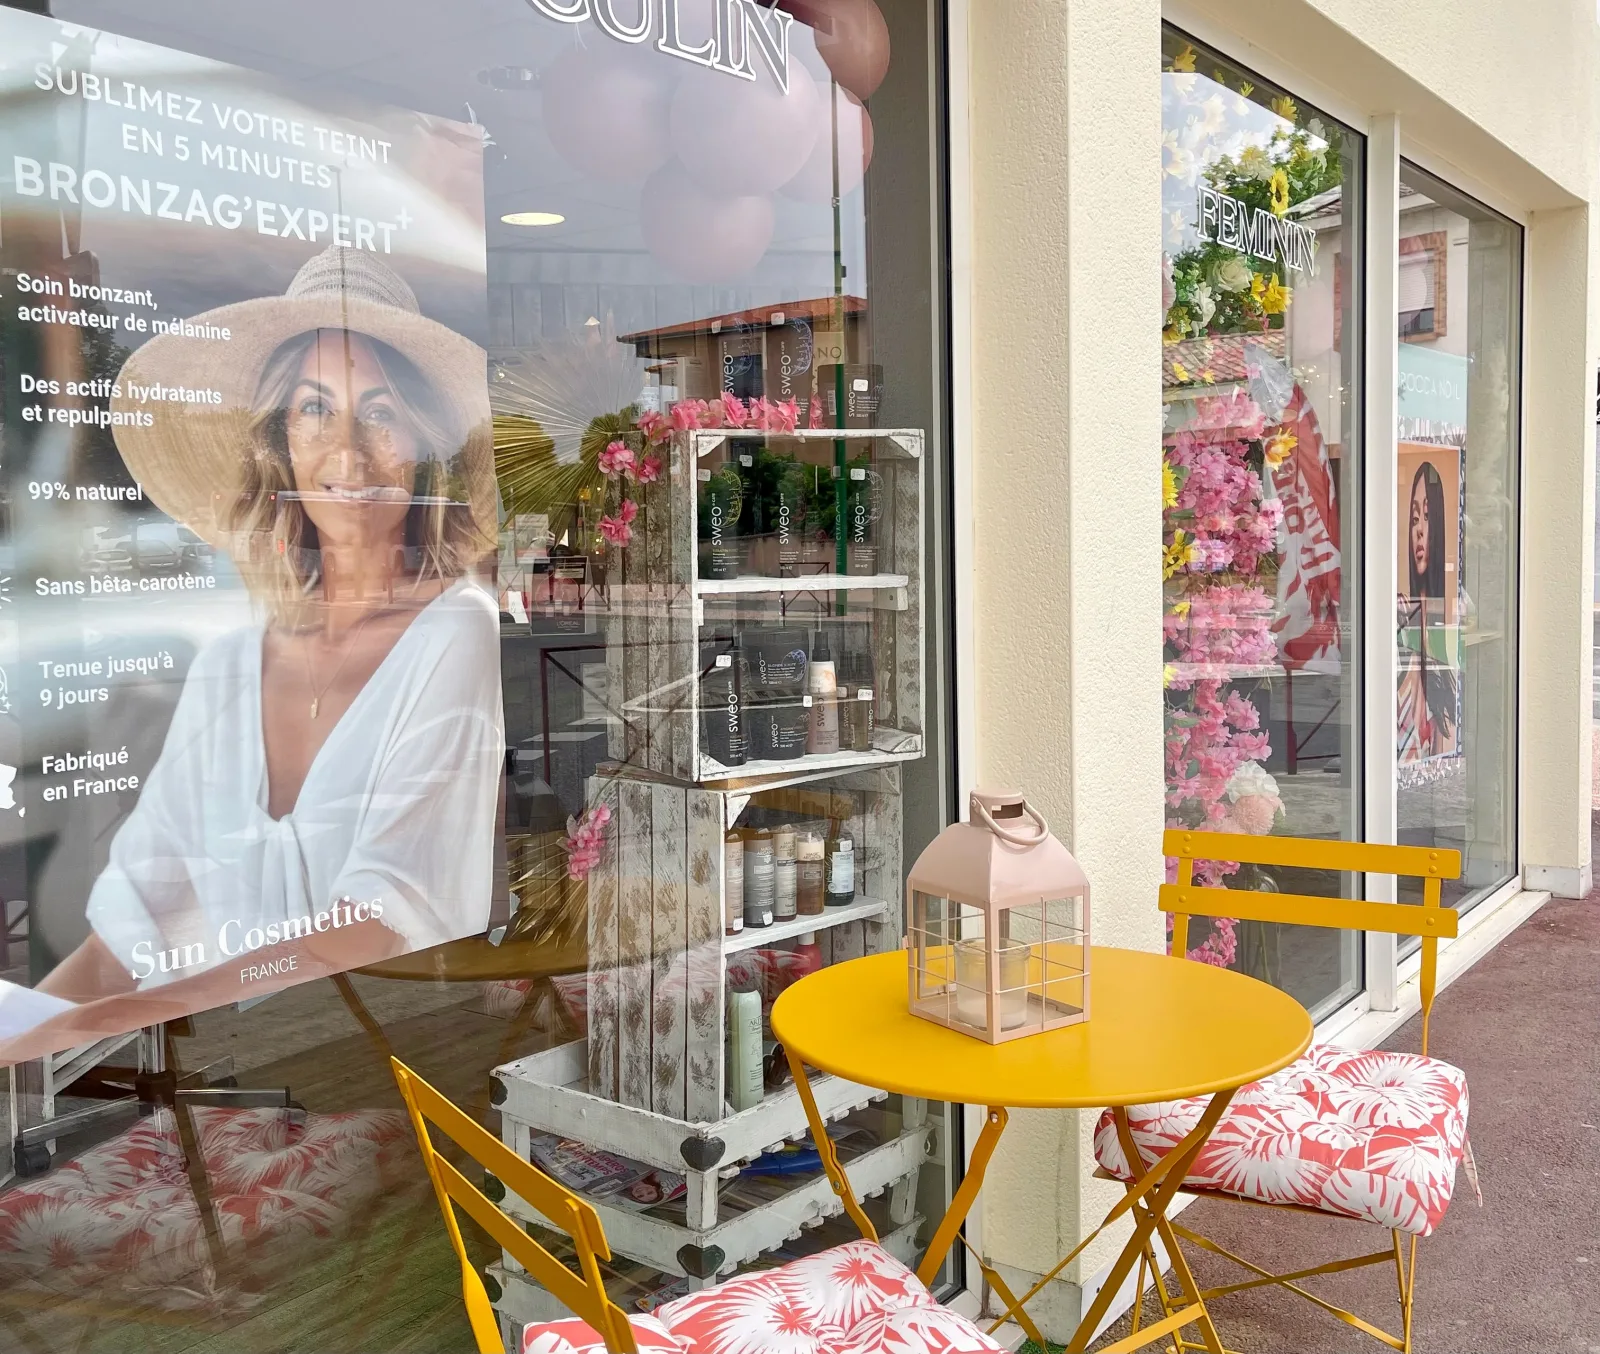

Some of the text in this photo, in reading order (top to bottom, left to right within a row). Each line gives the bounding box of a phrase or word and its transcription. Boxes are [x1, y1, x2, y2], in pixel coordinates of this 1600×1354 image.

[34, 63, 392, 164] SUBLIMEZ VOTRE TEINT
[122, 124, 332, 188] EN 5 MINUTES
[1197, 185, 1316, 277] FEMININ
[16, 273, 158, 311] Soin bronzant,
[17, 303, 231, 341] activateur de mélanine
[20, 374, 222, 404] Des actifs hydratants
[723, 354, 734, 394] sweo
[780, 354, 791, 395] sweo
[22, 404, 153, 429] et repulpants
[28, 481, 142, 501] 99% naturel
[712, 506, 722, 546] sweo
[780, 506, 790, 545] sweo
[855, 505, 865, 543] sweo
[35, 571, 215, 596] Sans bêta-carotène
[39, 651, 174, 680] Tenue jusqu'à
[40, 684, 108, 707] 9 jours
[728, 694, 738, 733] sweo
[42, 746, 129, 775] Fabriqué
[43, 772, 139, 802] en France
[131, 895, 384, 981] Sun Cosmetics
[240, 955, 298, 985] FRANCE
